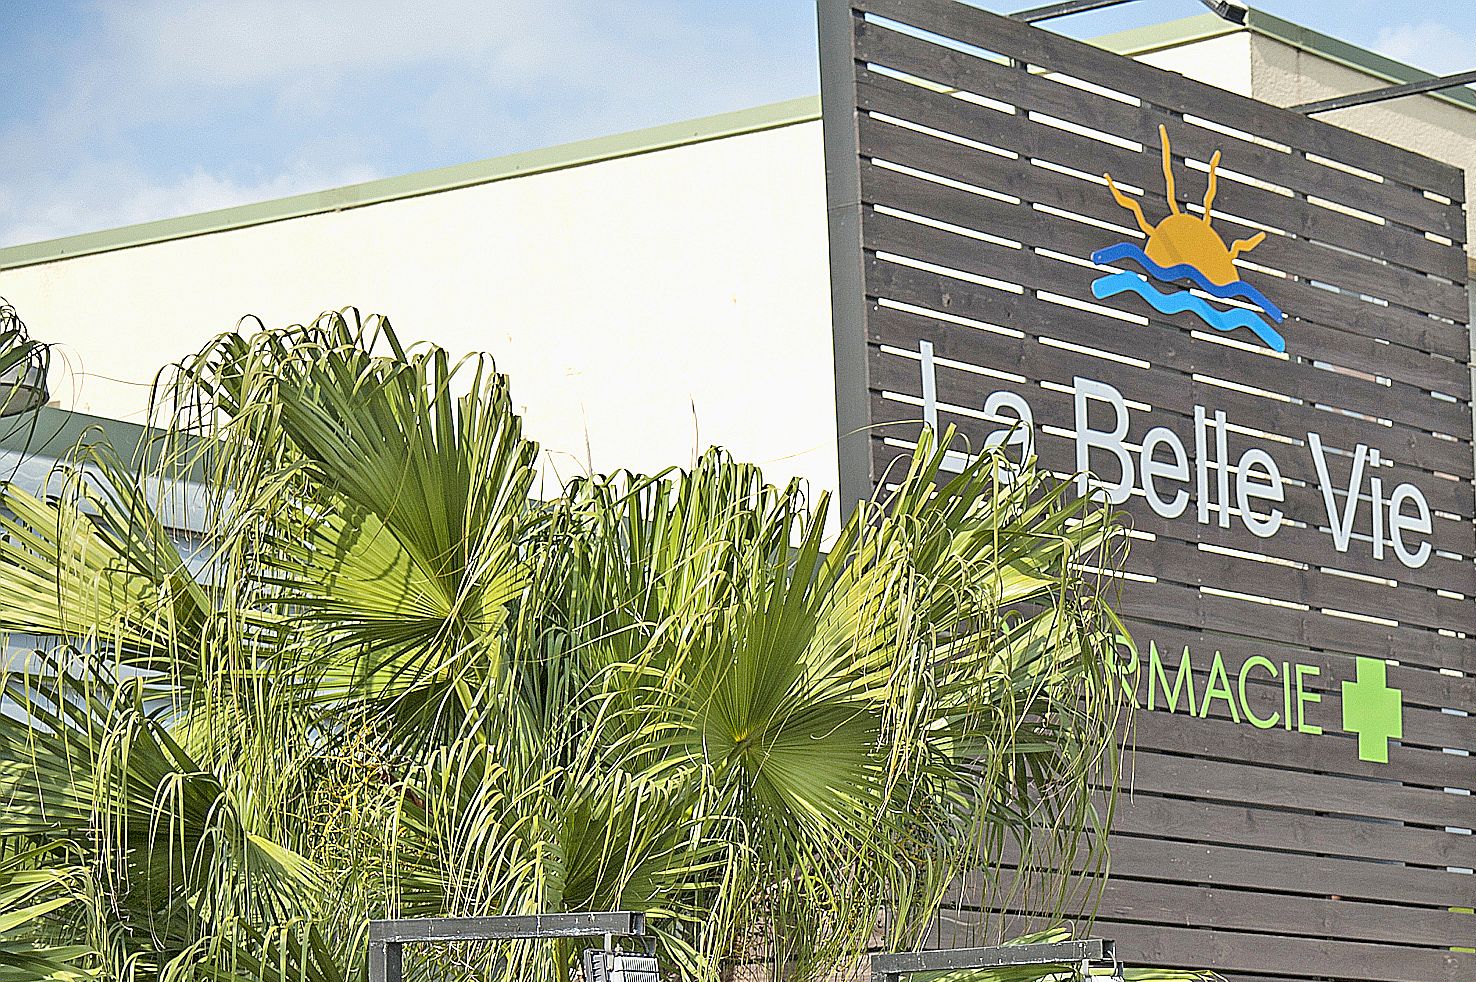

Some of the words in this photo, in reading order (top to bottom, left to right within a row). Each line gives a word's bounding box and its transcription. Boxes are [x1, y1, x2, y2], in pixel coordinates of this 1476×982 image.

[919, 340, 1034, 486] La
[1073, 376, 1285, 538] Belle
[1308, 432, 1434, 568] Vie
[1106, 634, 1323, 736] RMACIE
